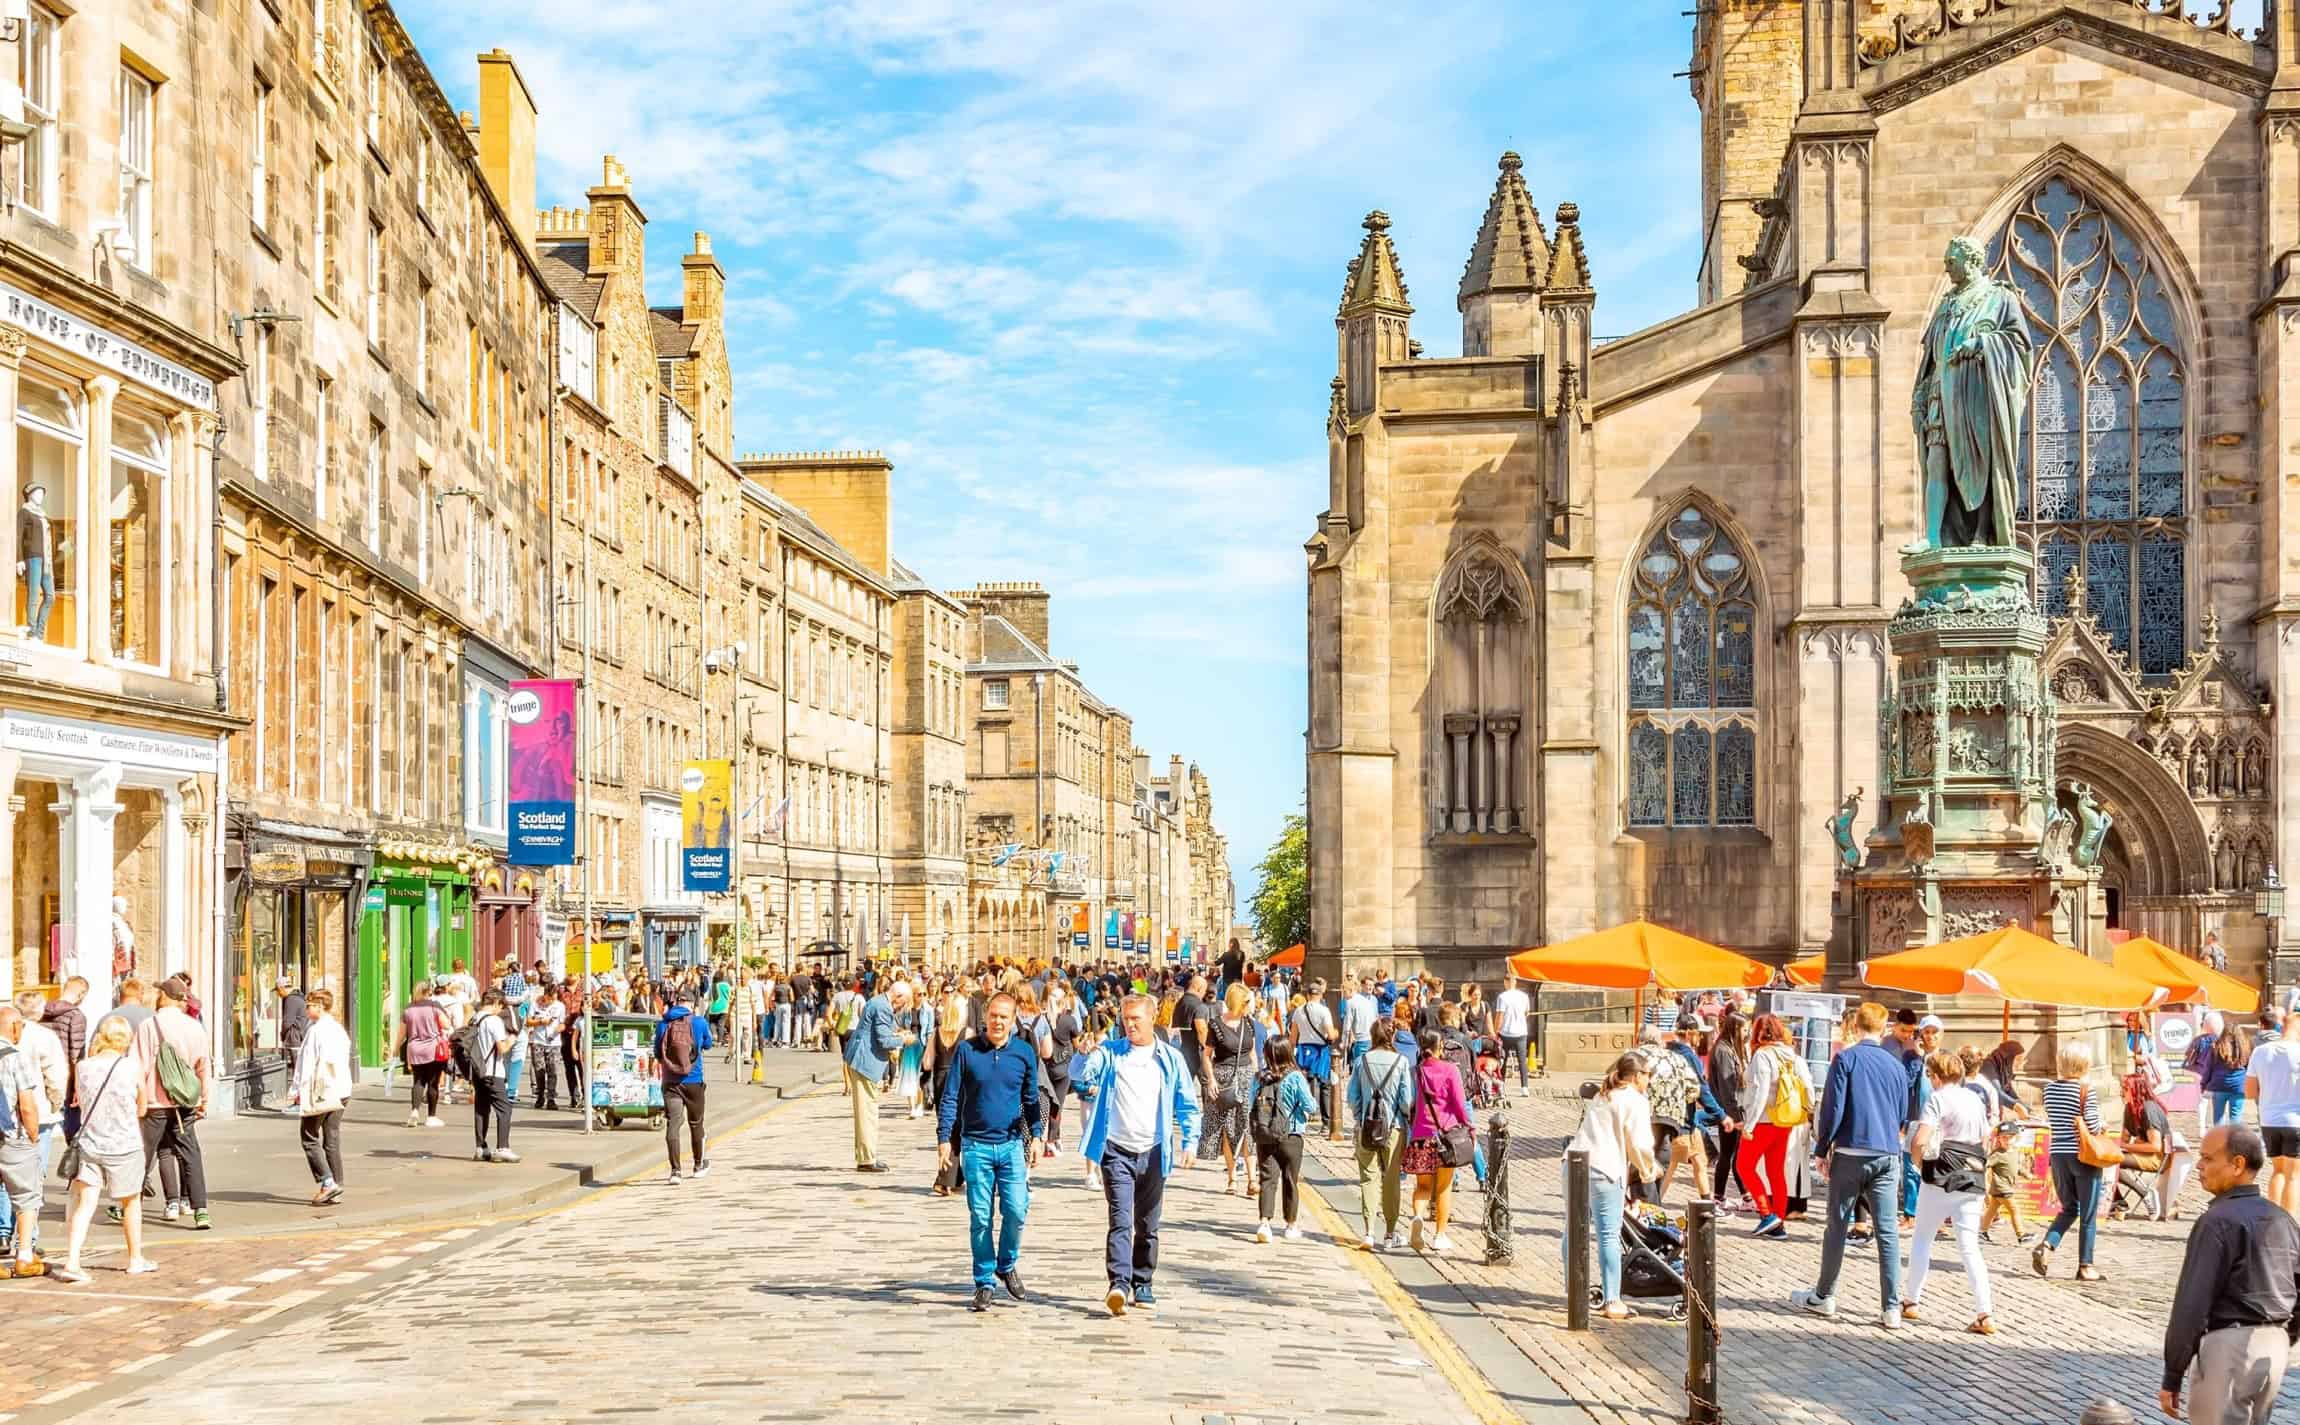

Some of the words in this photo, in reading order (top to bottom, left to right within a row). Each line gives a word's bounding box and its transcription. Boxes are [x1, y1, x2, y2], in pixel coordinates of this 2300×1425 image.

[8, 295, 70, 341] HOUSE
[85, 332, 109, 357] OF
[121, 347, 211, 403] EDINBURGH
[510, 701, 537, 714] fringe
[9, 722, 55, 745] Beautifully
[57, 729, 89, 745] Scottish
[518, 811, 566, 824] Scotland
[688, 853, 724, 863] Scotland
[1578, 1034, 1600, 1049] ST
